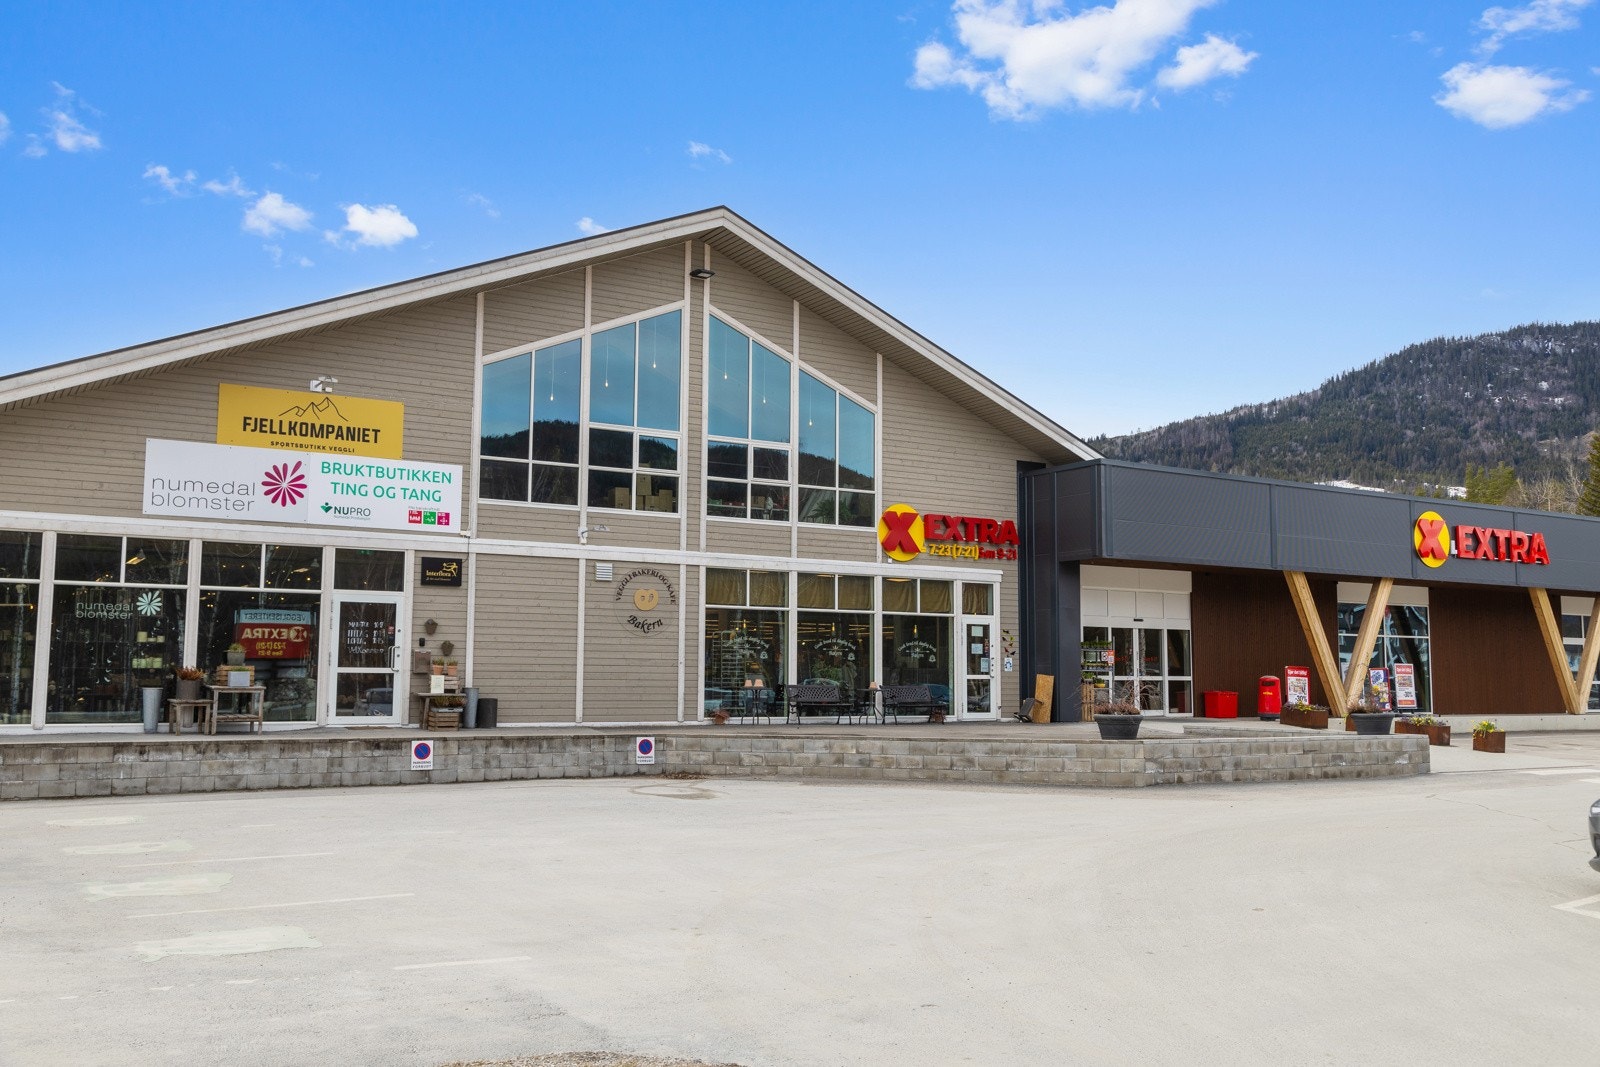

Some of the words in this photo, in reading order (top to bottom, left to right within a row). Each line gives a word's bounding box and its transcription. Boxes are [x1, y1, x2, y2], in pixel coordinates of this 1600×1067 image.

[243, 416, 380, 443] FJELLKOMPANIET
[270, 440, 326, 451] SPORTSBUTIKK
[321, 461, 452, 484] BRUKTBUTIKKEN
[152, 477, 256, 496] numedal
[331, 481, 368, 497] TING
[373, 485, 396, 499] OG
[400, 487, 442, 502] TANG
[151, 491, 255, 511] blomster
[334, 506, 371, 517] NUPRO
[924, 514, 1019, 546] EXTRA
[997, 548, 1016, 559] 9-21
[1456, 525, 1550, 565] EXTRA
[616, 574, 632, 601] VEGGLI
[659, 574, 668, 585] OG
[75, 609, 133, 620] blomster
[76, 601, 133, 611] numedal
[627, 615, 663, 634] Bakern
